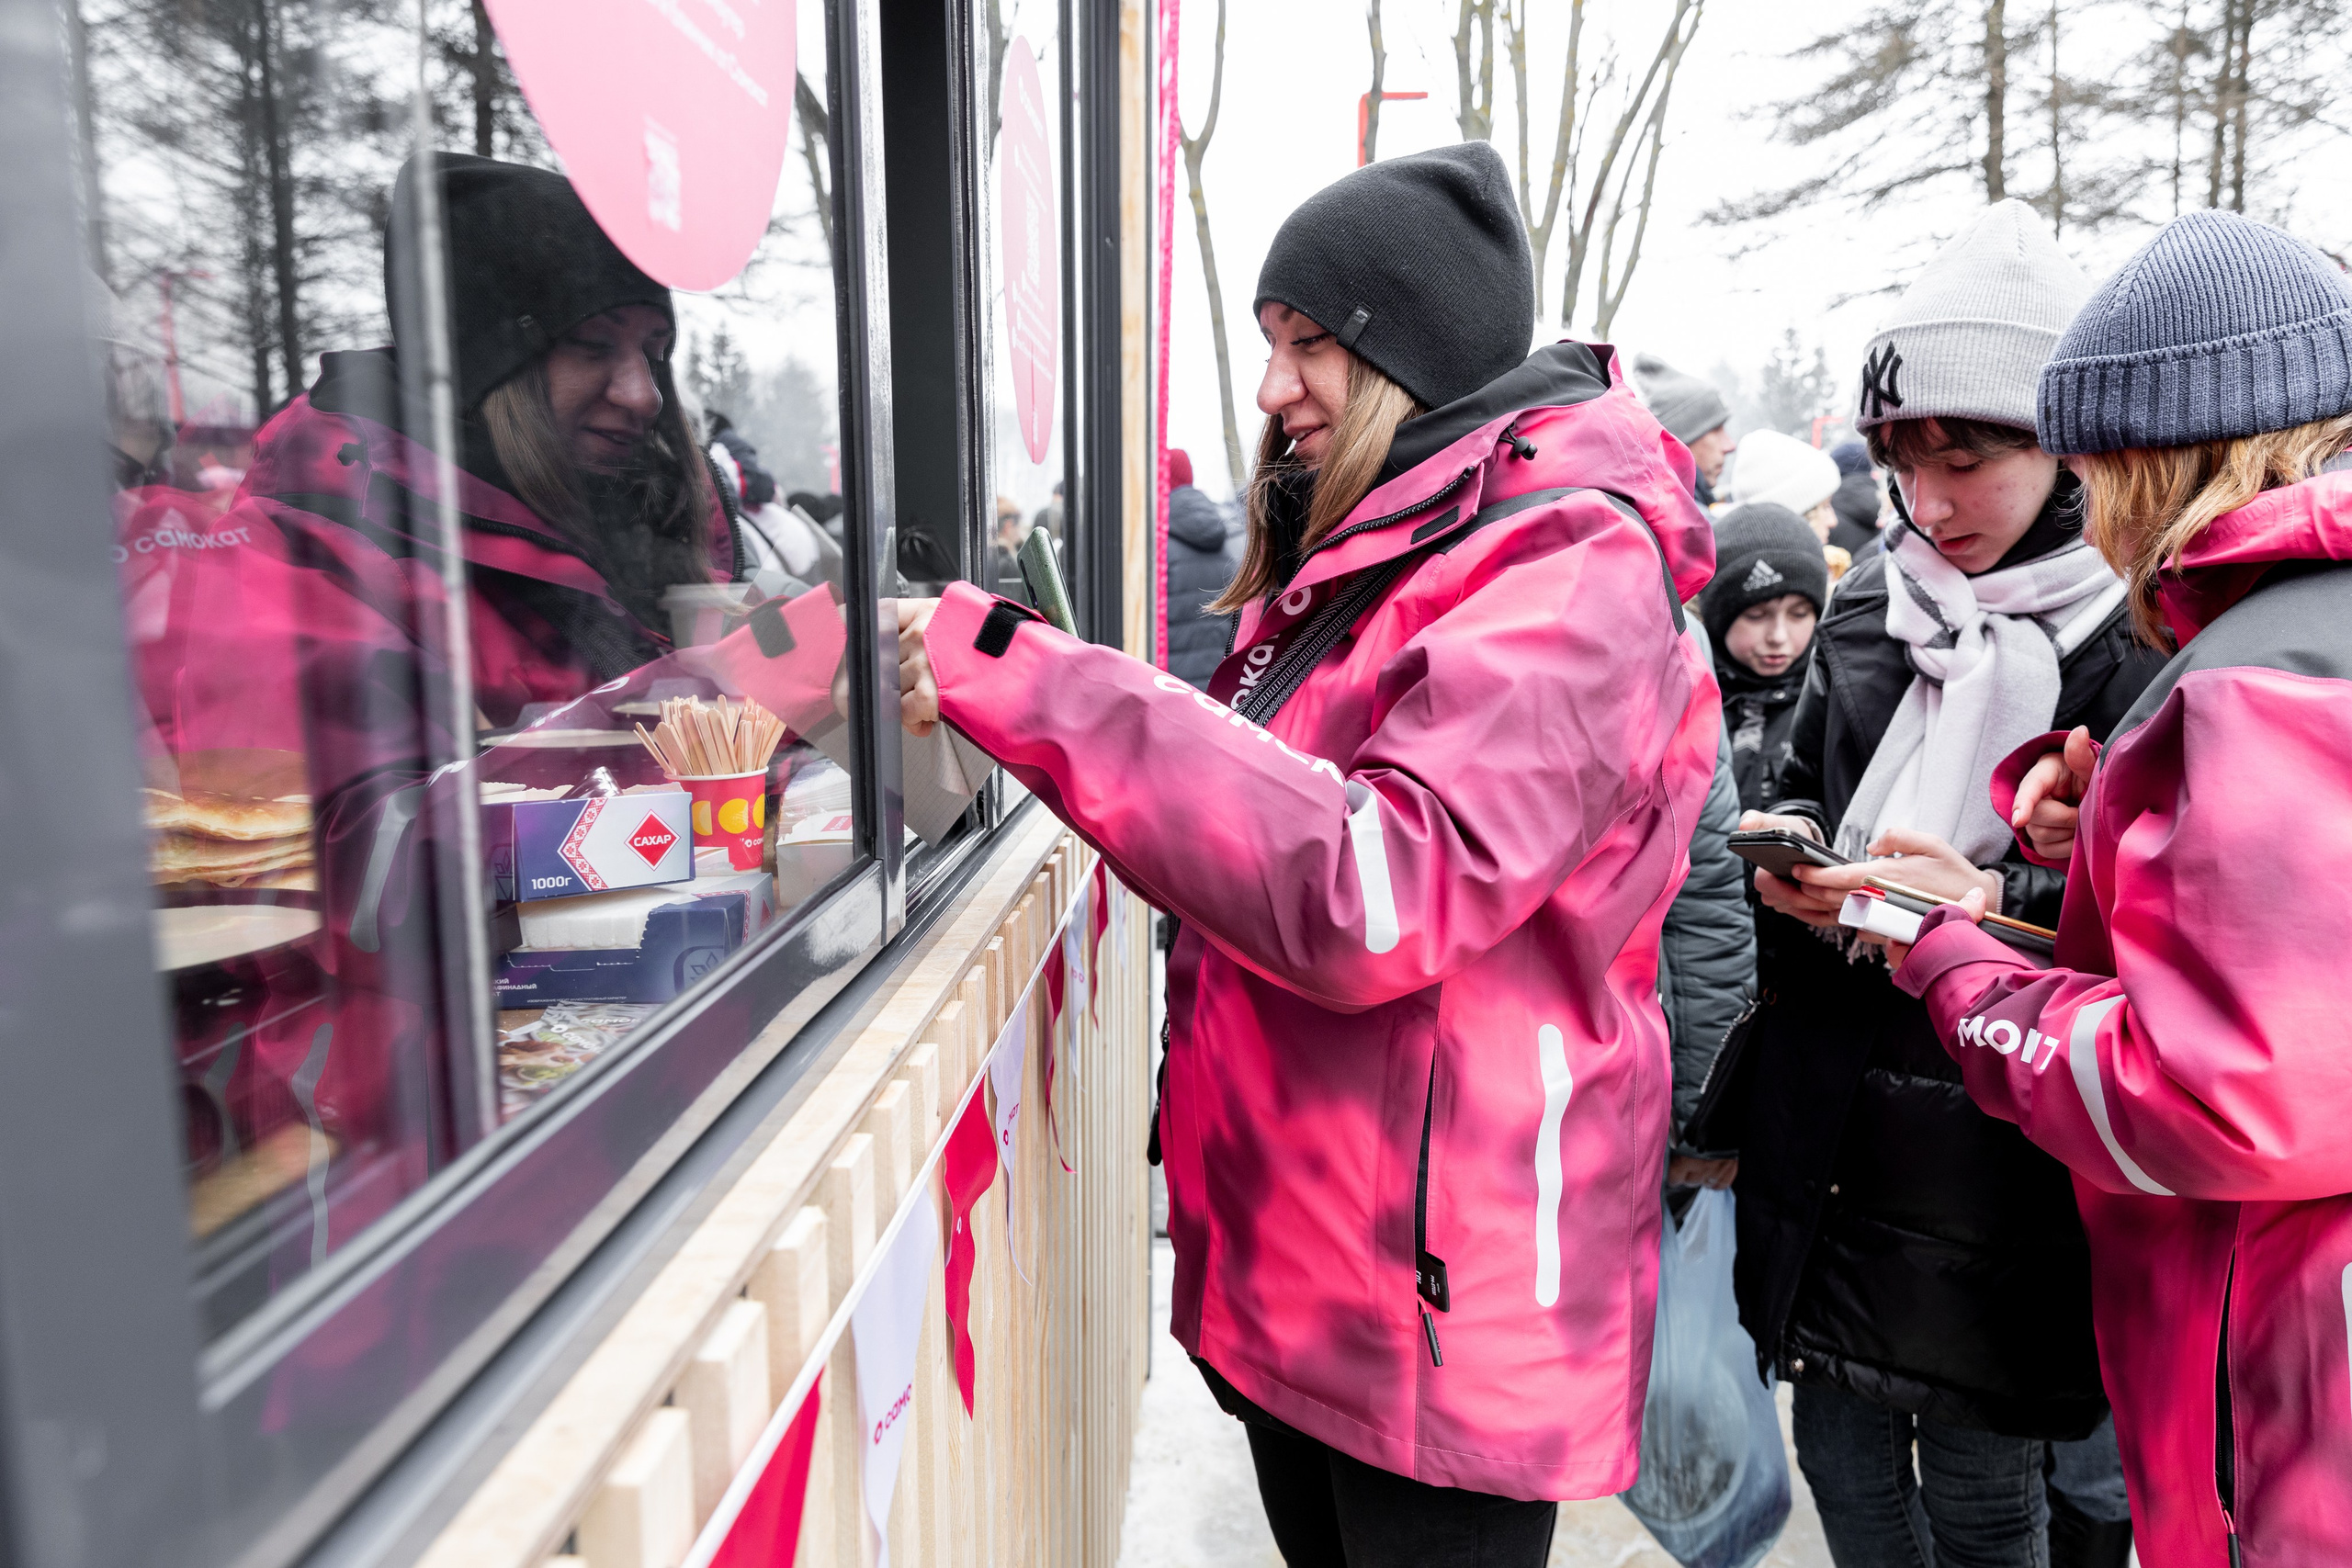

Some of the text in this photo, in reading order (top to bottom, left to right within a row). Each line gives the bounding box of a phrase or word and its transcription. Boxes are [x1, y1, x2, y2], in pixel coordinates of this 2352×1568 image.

[1860, 340, 1904, 418] NY
[633, 834, 672, 847] САХАР
[531, 875, 572, 890] 1000г
